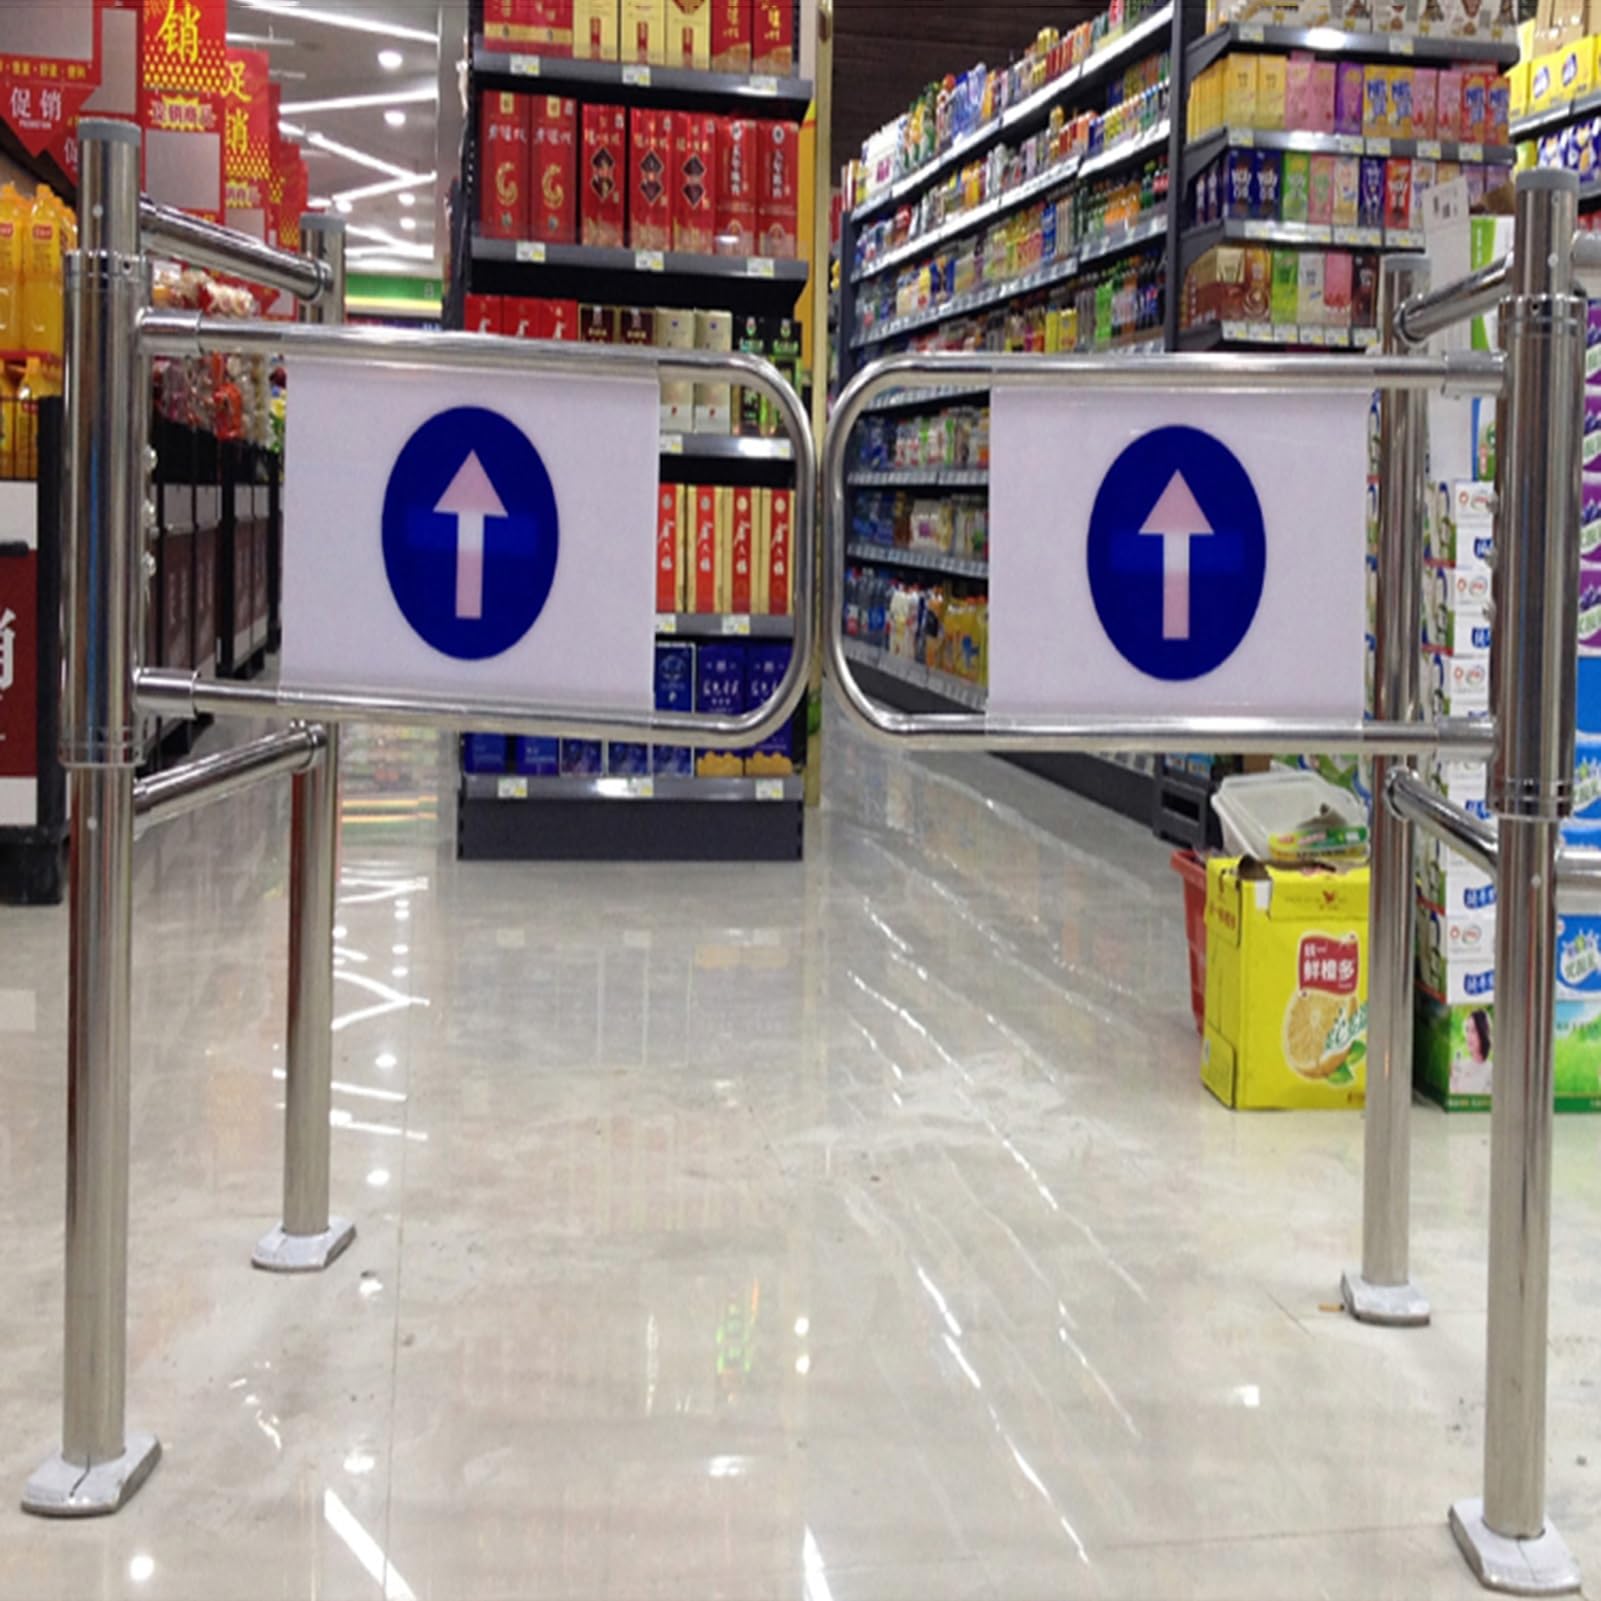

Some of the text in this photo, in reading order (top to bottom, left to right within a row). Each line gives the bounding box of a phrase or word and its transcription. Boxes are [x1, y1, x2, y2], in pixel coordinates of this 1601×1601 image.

[157, 0, 201, 64] 销
[10, 87, 62, 121] 促销
[1303, 959, 1355, 982] 鲜橙多
